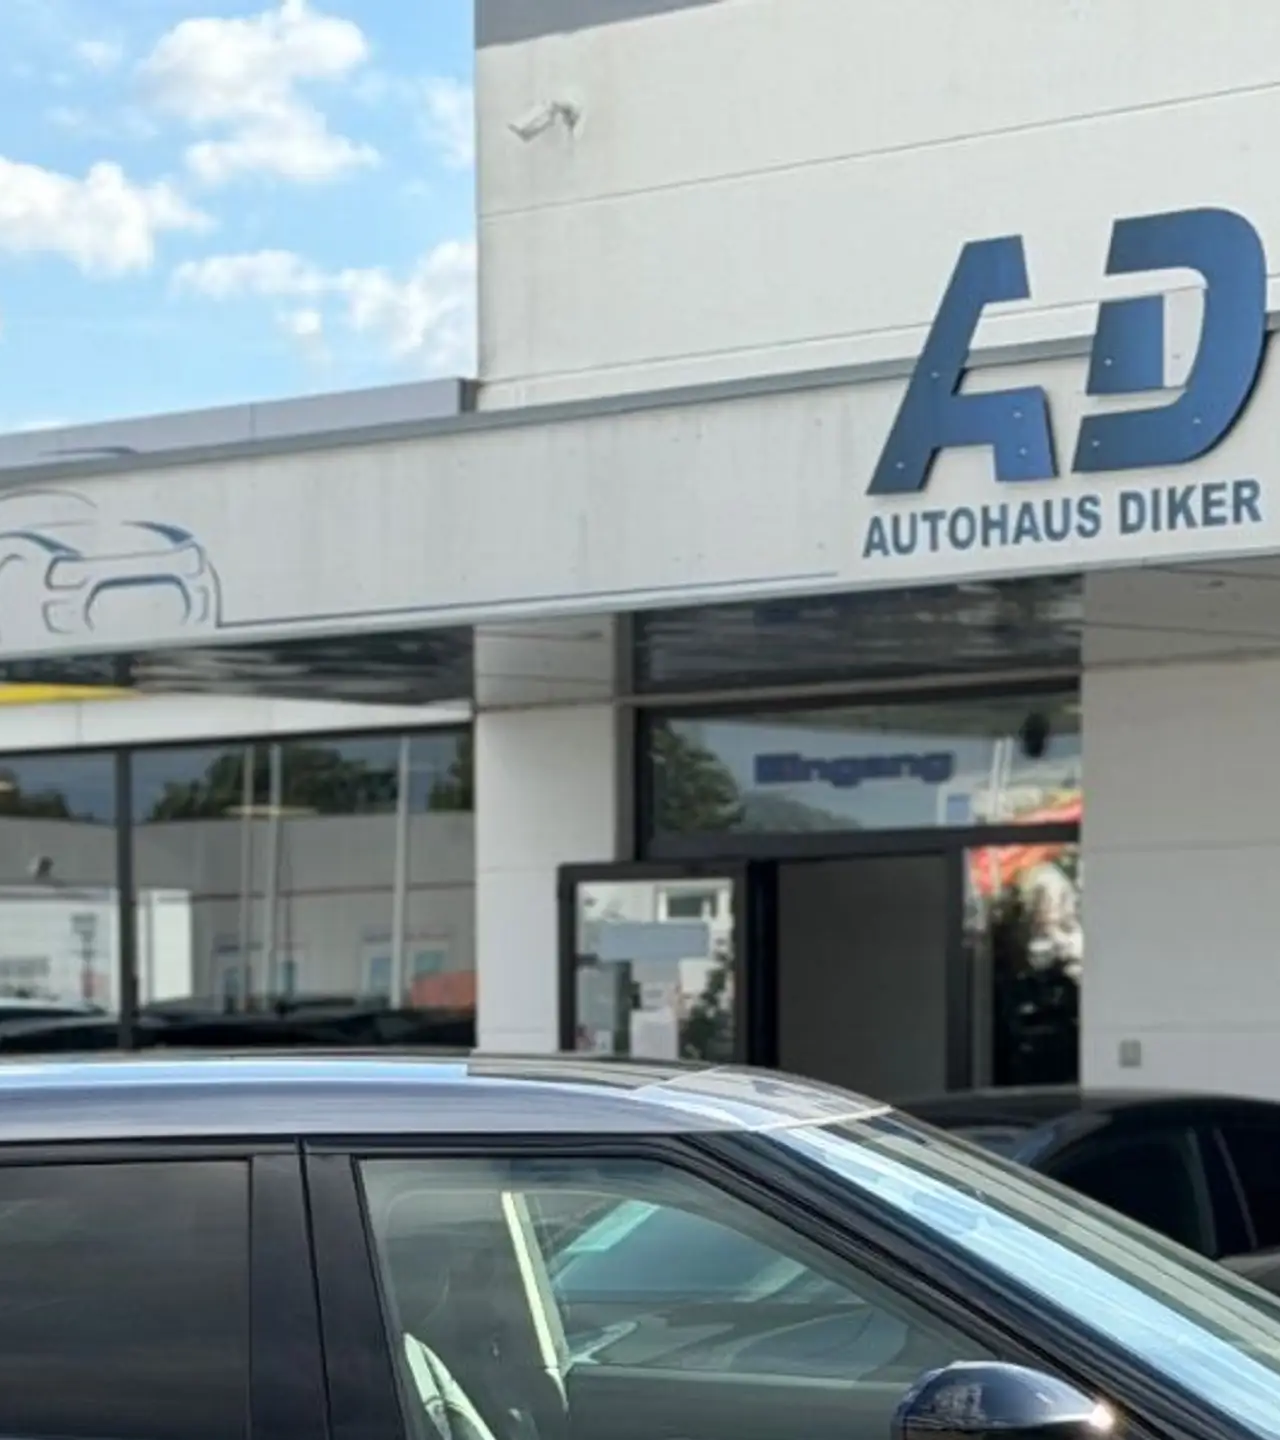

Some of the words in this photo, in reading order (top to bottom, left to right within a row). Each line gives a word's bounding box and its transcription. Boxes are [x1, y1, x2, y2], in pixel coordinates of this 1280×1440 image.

[865, 206, 1268, 497] AD
[862, 495, 1102, 559] AUTOHAUS
[1118, 478, 1263, 536] DIKER
